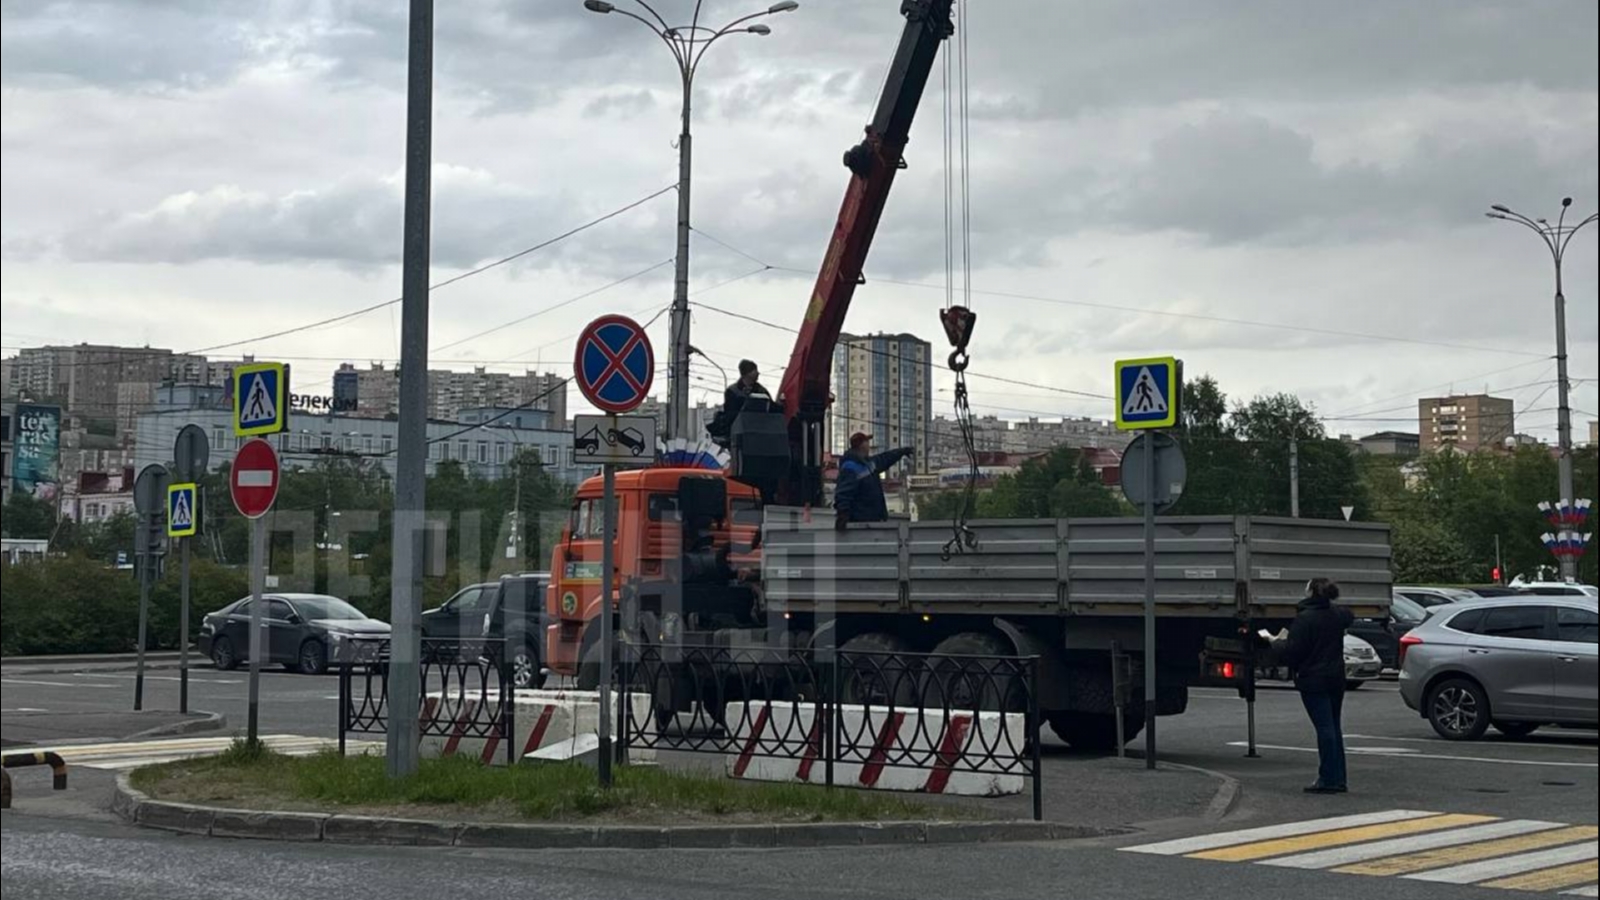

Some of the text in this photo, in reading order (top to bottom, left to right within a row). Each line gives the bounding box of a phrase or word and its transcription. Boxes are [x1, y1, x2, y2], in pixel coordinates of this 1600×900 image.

[20, 414, 47, 430] ter
[20, 430, 50, 445] ras
[18, 445, 40, 459] sa
